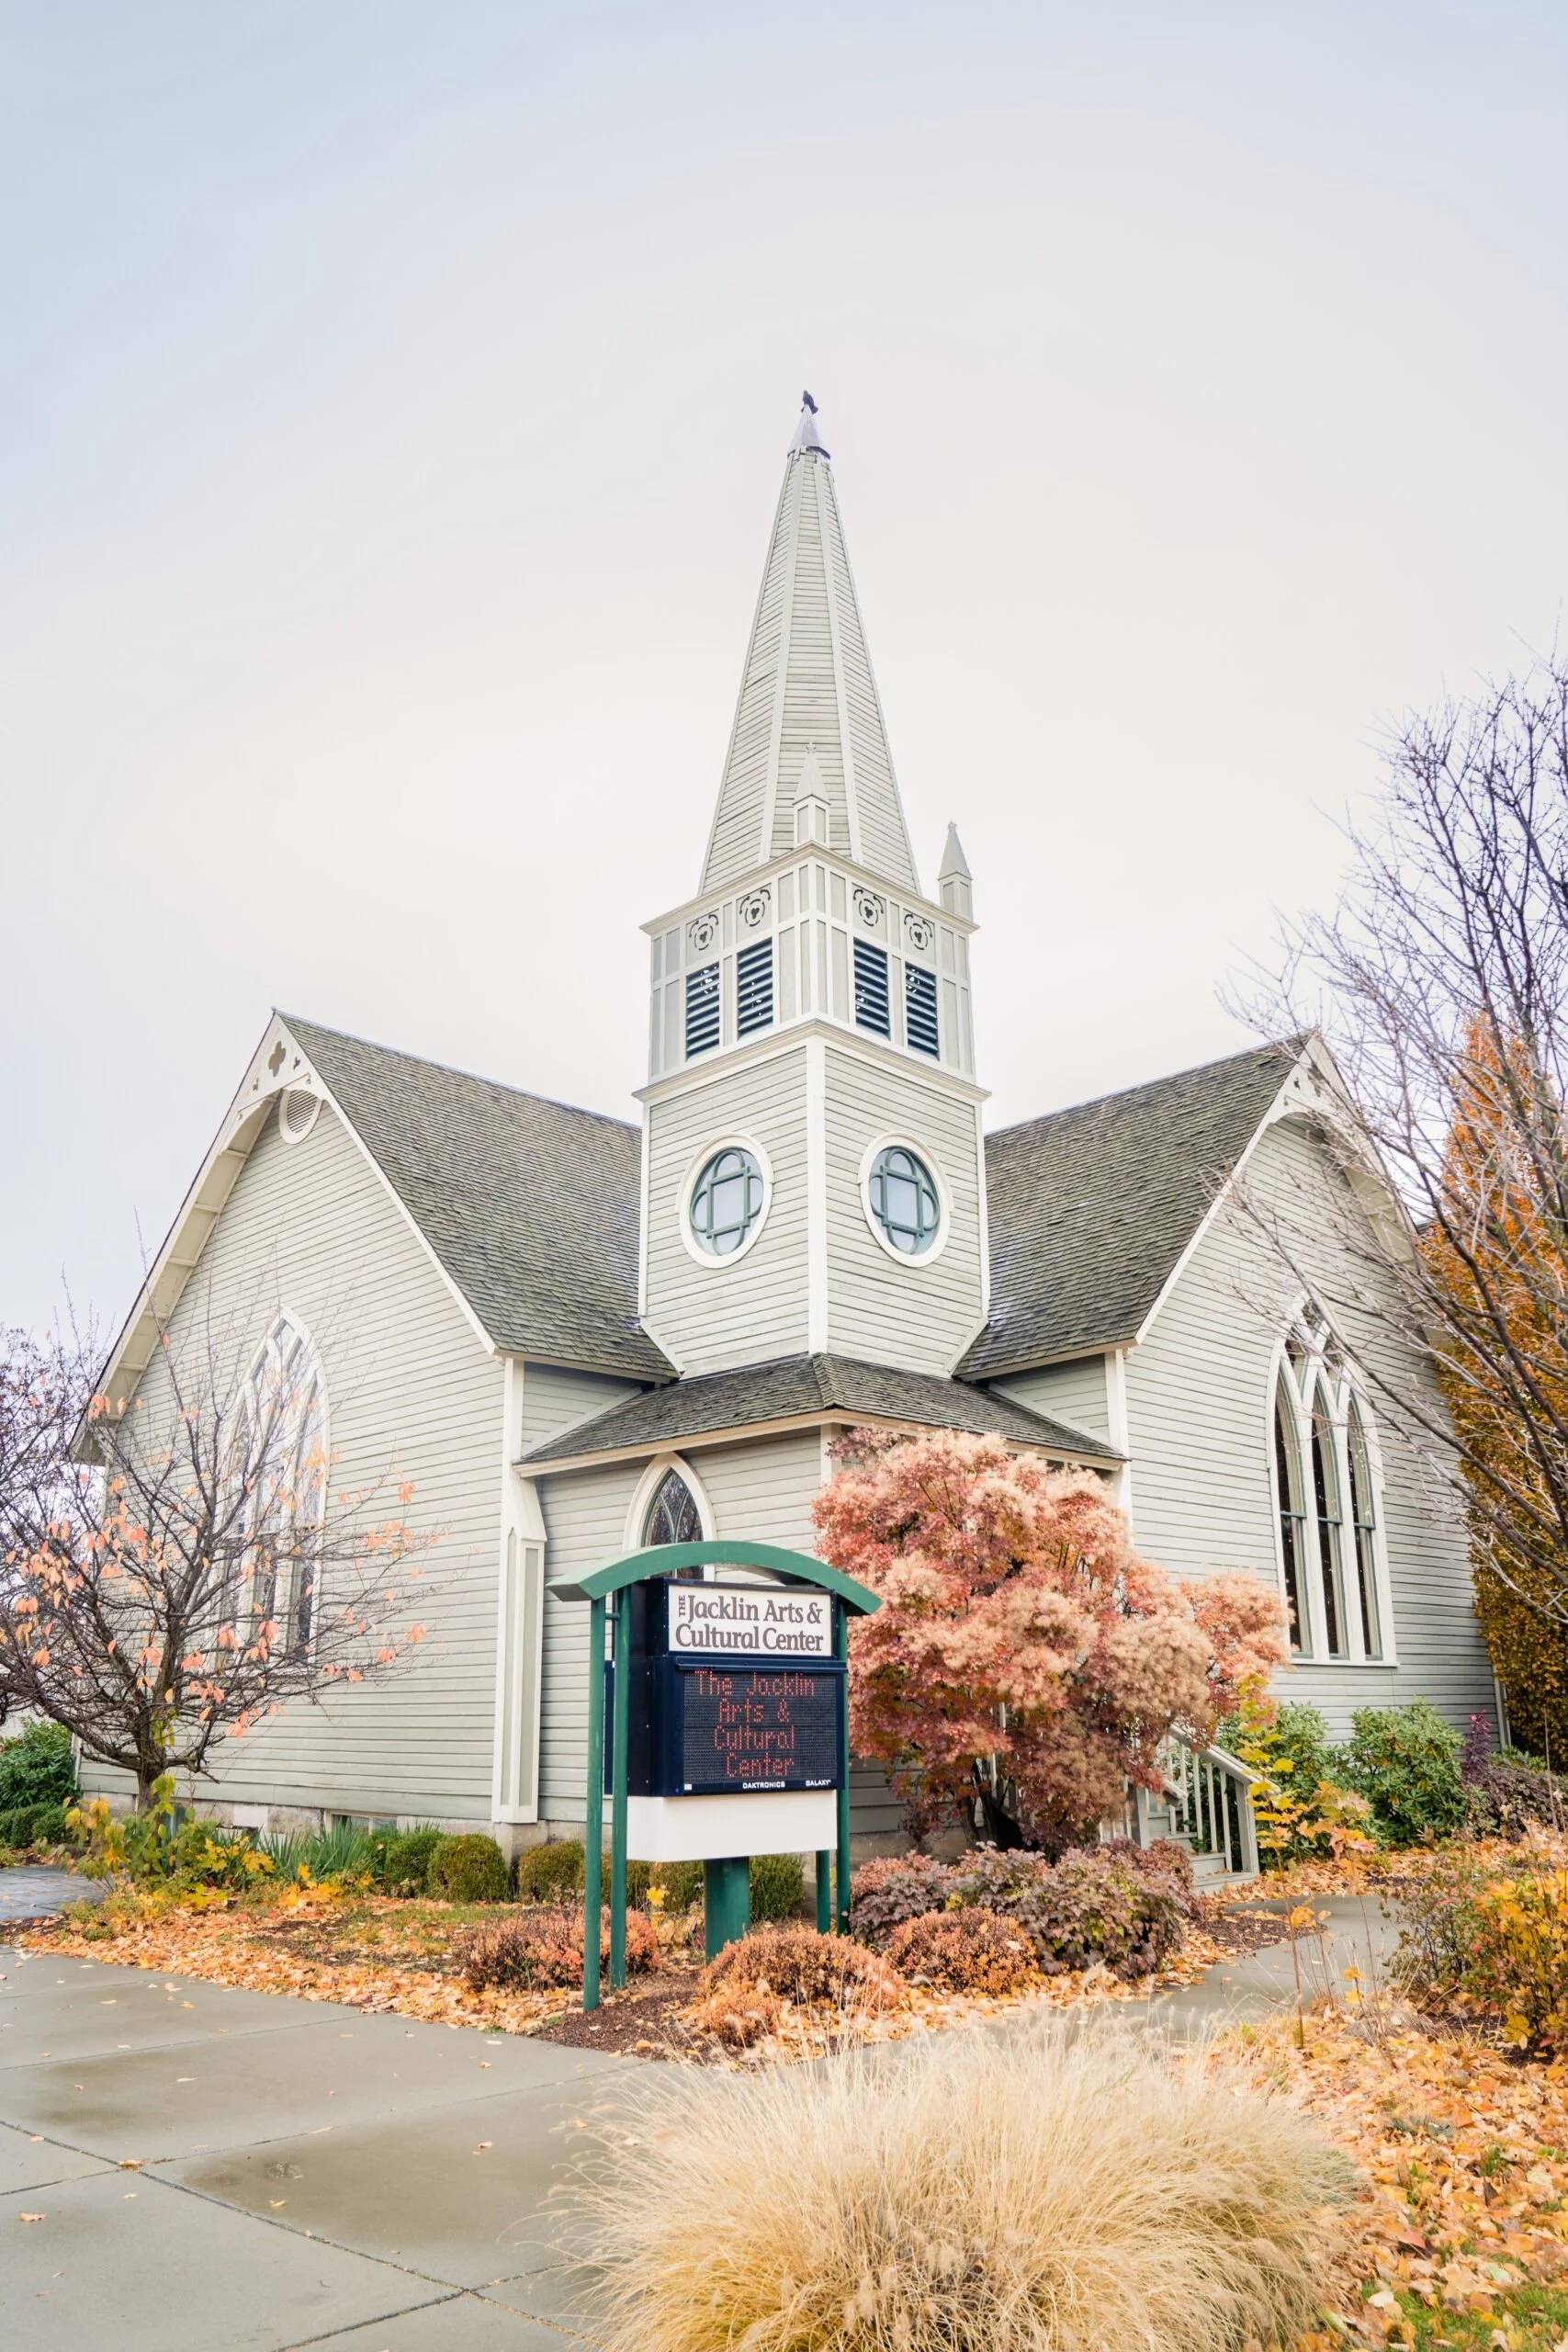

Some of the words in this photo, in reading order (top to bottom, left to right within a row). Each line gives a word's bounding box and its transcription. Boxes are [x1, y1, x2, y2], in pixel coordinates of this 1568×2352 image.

[678, 1595, 686, 1617] THE
[687, 1595, 760, 1623] Jacklin
[763, 1600, 804, 1623] Arts
[807, 1601, 823, 1624] &
[675, 1623, 760, 1649] Cultural
[762, 1627, 823, 1651] Center
[694, 1669, 733, 1696] The
[747, 1671, 816, 1696] Jacklin
[719, 1699, 764, 1723] Arts
[777, 1699, 791, 1722] &
[714, 1725, 795, 1750] Cultural
[726, 1753, 795, 1778] Center
[742, 1781, 785, 1789] DAKTRONICS
